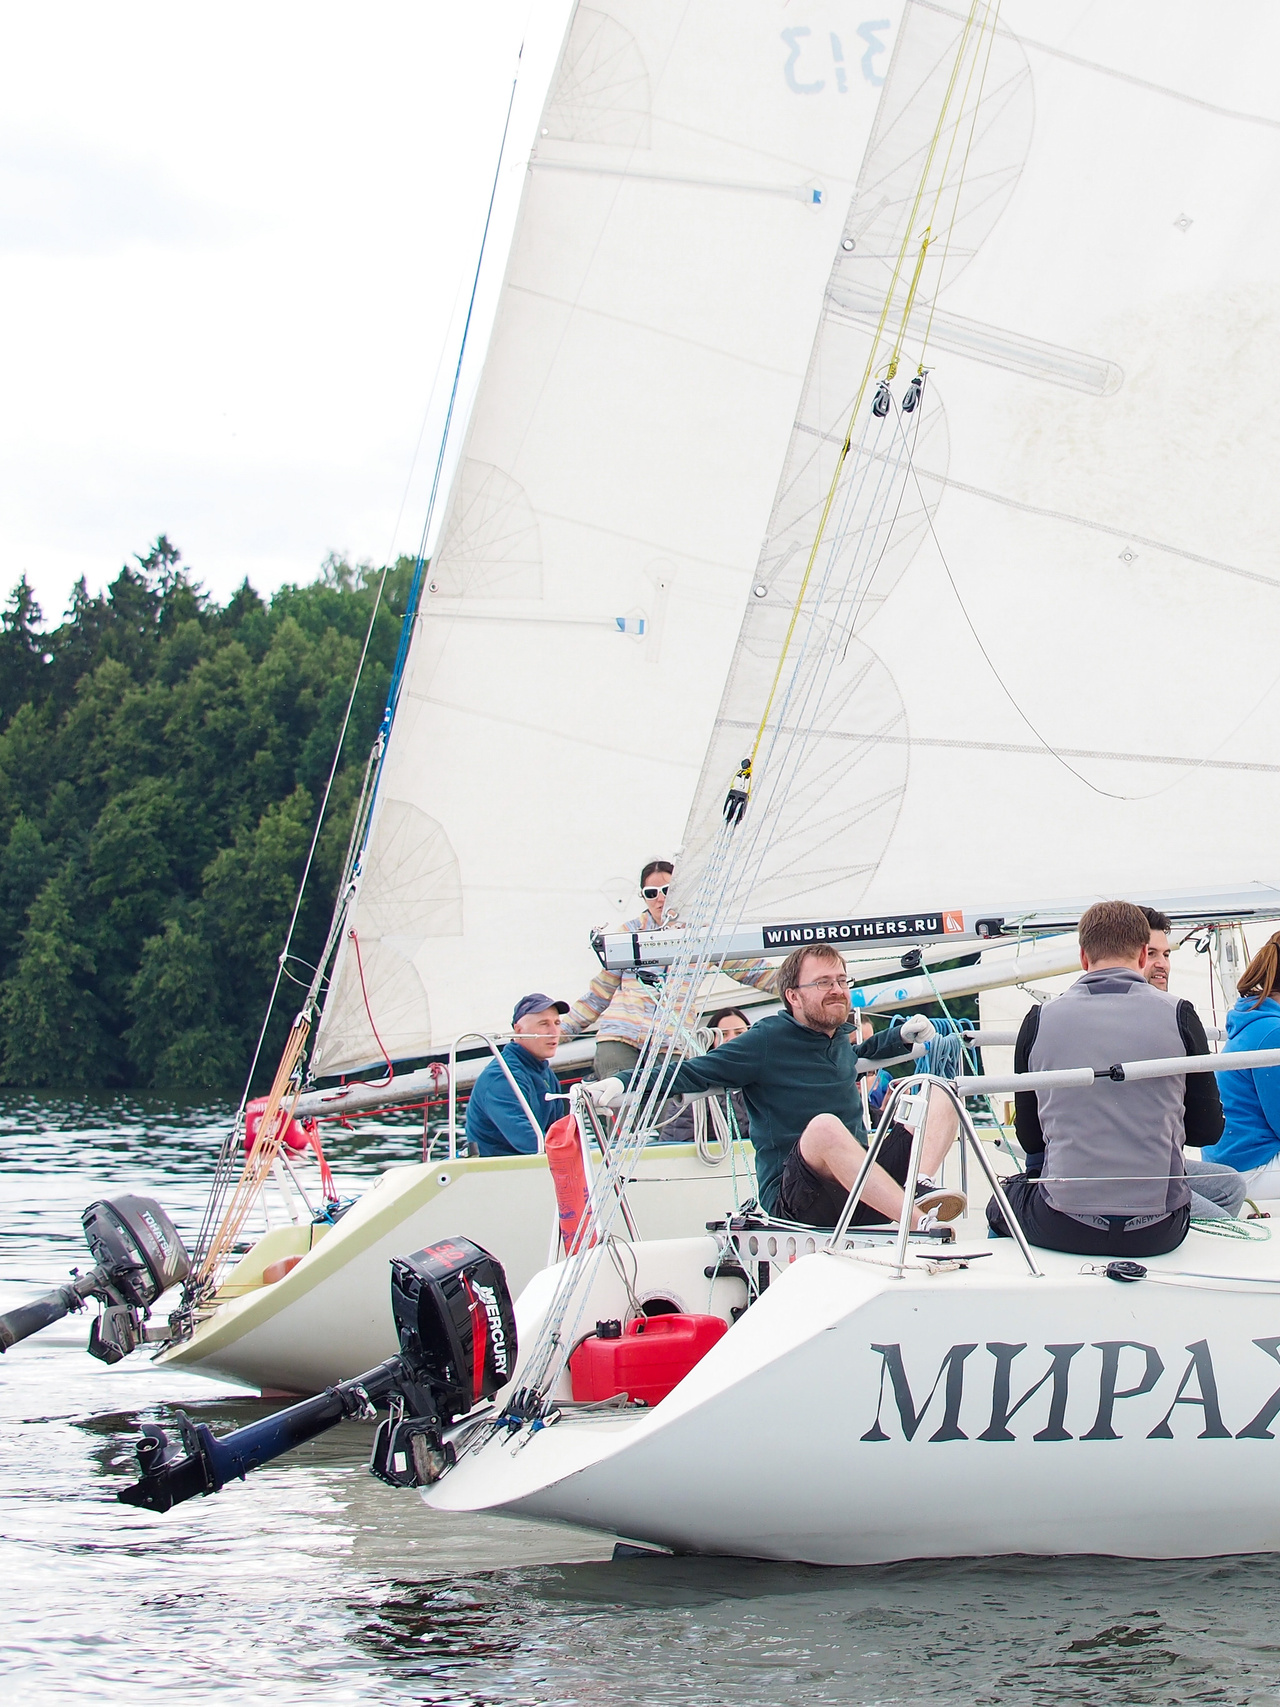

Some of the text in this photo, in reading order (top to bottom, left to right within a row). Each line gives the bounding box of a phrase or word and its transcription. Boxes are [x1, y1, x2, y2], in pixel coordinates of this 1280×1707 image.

[767, 918, 938, 943] WINDBROTHERS.RU
[142, 1210, 173, 1257] TOHATSU
[479, 1284, 508, 1375] MERCURY
